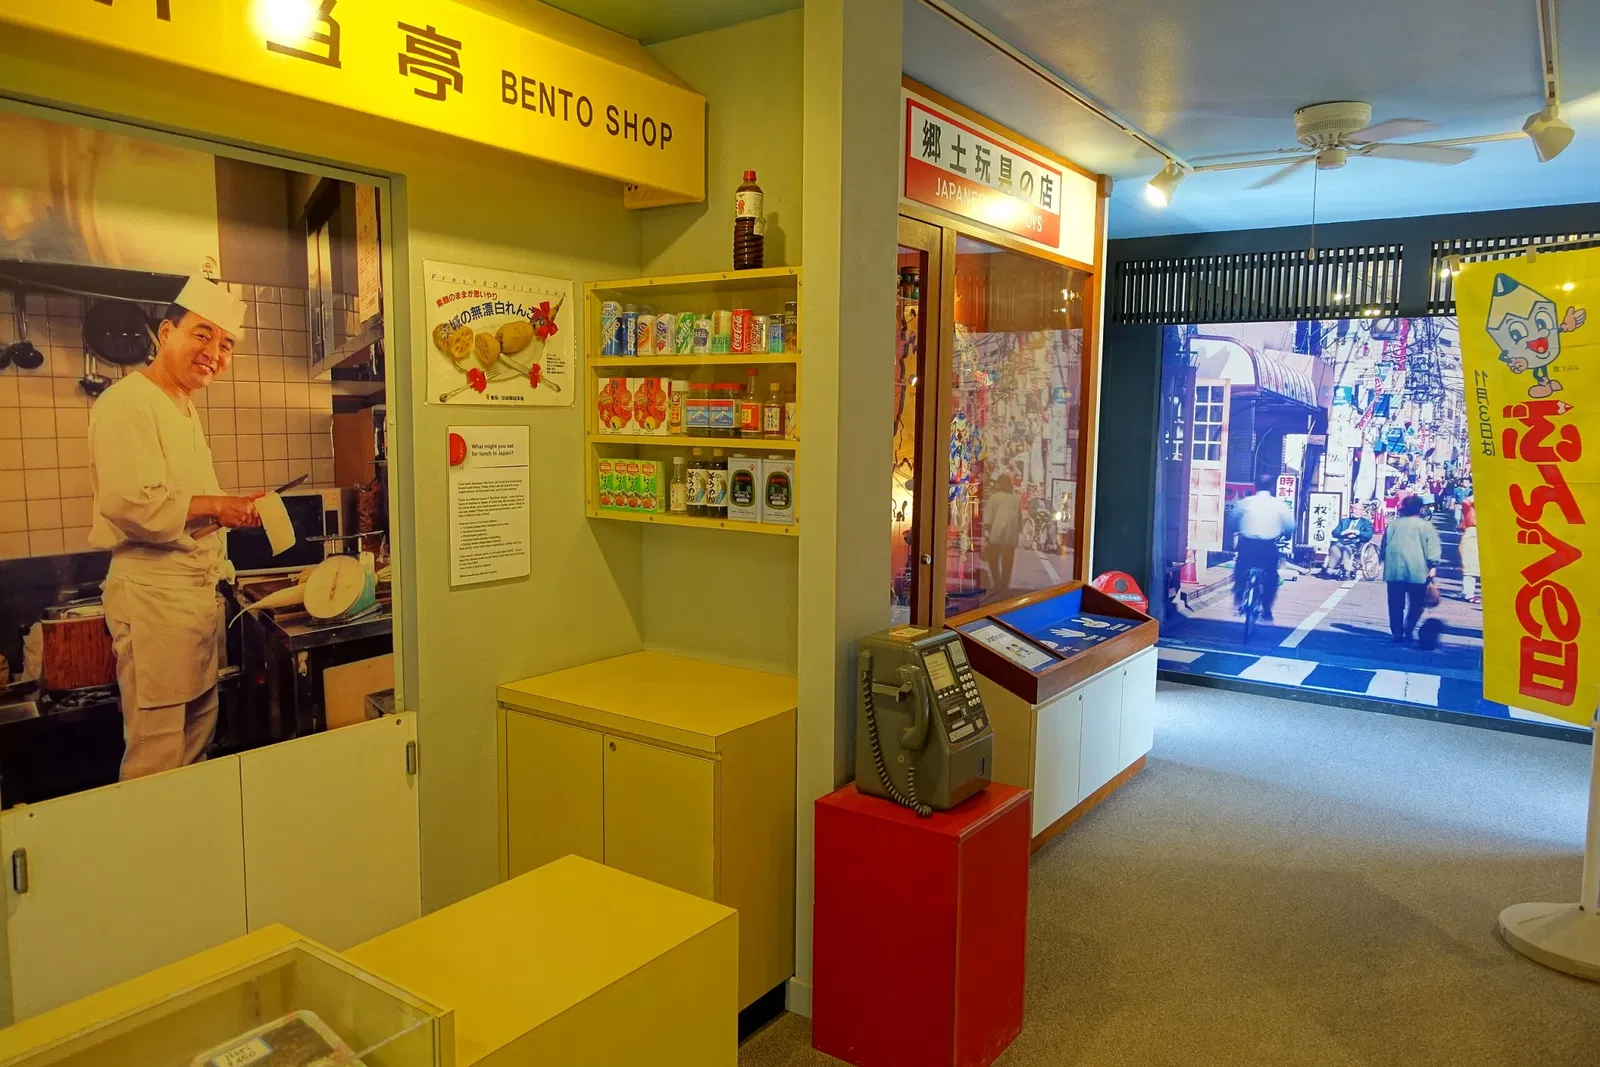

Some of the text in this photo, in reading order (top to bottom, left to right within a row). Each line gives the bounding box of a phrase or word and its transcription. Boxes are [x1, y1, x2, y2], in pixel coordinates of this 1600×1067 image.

[502, 69, 673, 150] BENTO SHOP
[922, 119, 1054, 209] 郷土玩具の店
[1025, 214, 1043, 232] OYS
[676, 319, 693, 347] Sprite
[708, 472, 716, 503] そうめん
[1278, 477, 1295, 497] 時計
